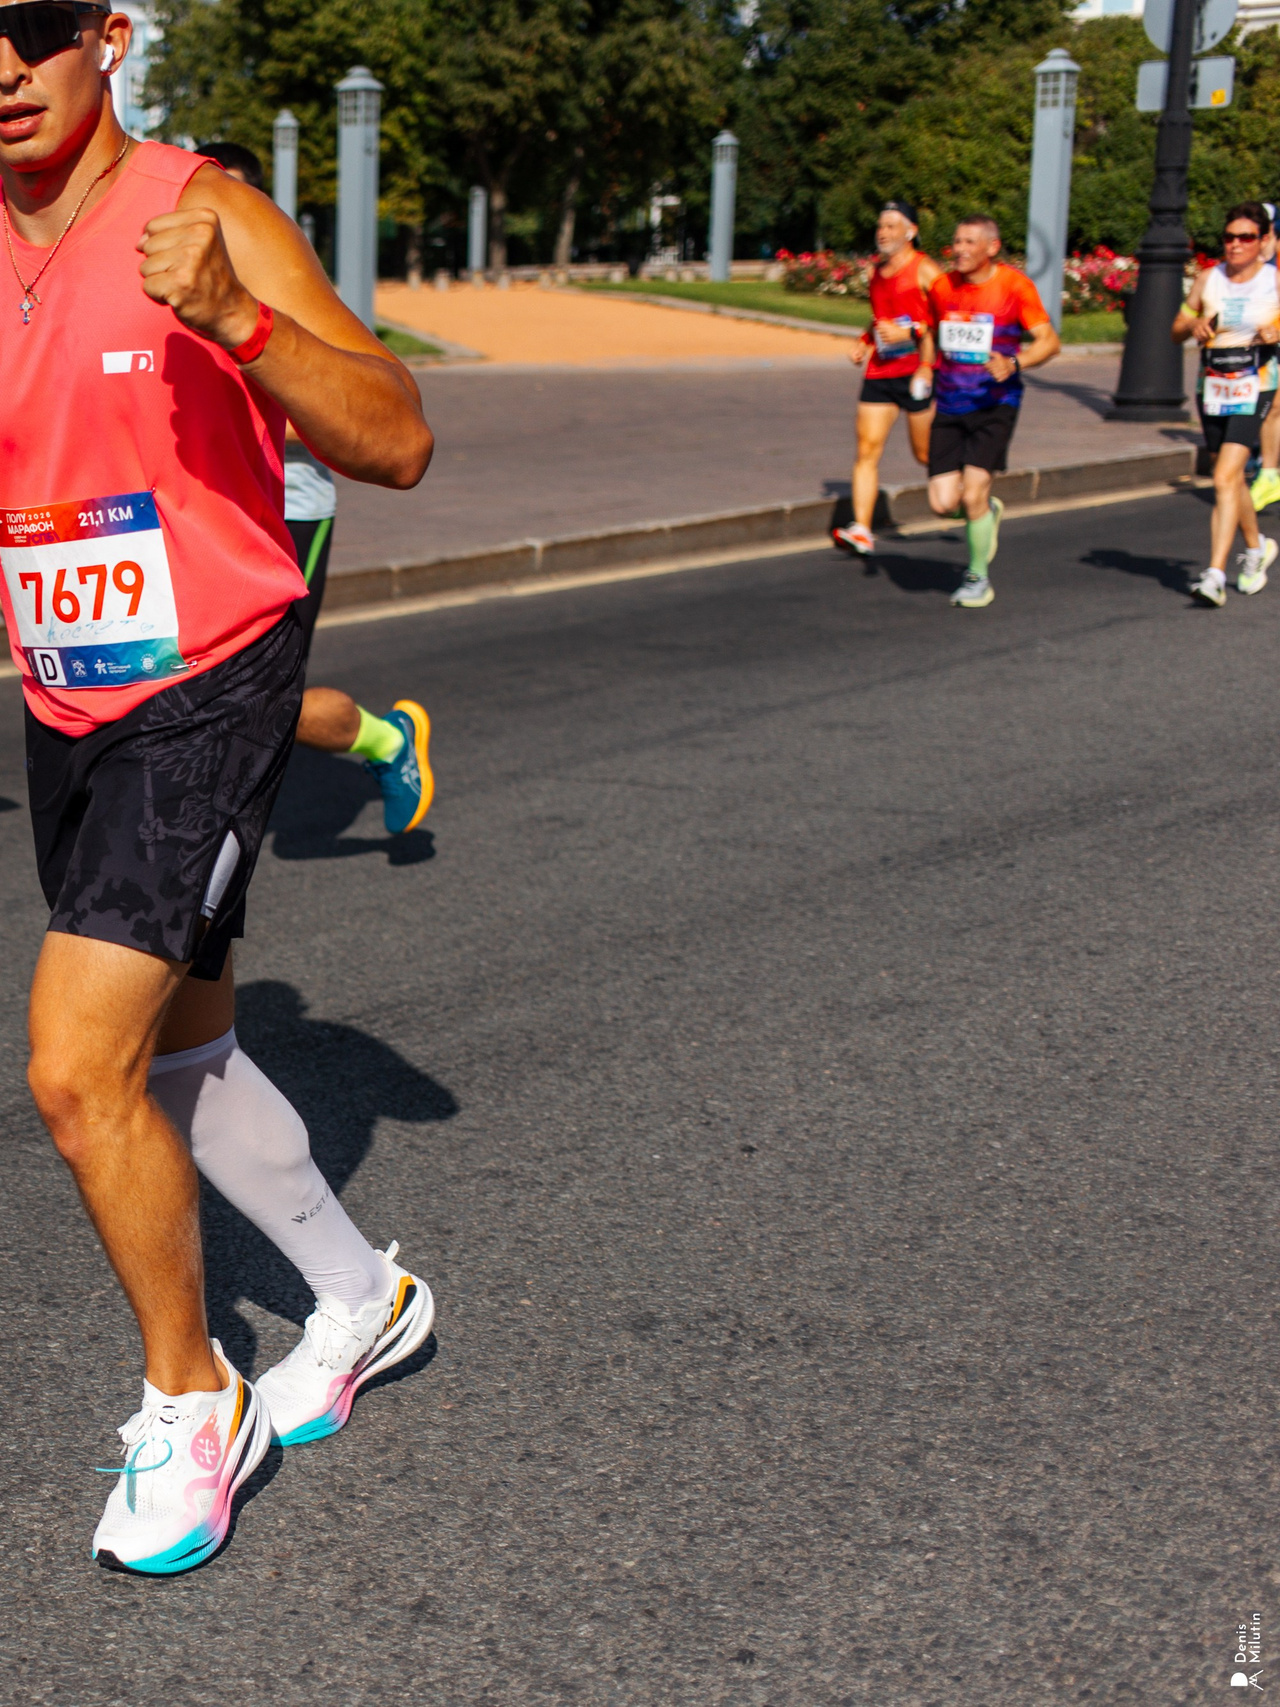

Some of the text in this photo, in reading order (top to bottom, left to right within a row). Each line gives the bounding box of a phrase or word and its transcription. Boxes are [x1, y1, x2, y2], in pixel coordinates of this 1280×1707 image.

[947, 327, 985, 344] 5962
[5, 512, 27, 524] ПОЛУ
[78, 505, 134, 527] 21,1 КМ
[7, 519, 55, 535] МАРАФОН
[18, 560, 145, 625] 7679
[39, 653, 58, 681] D
